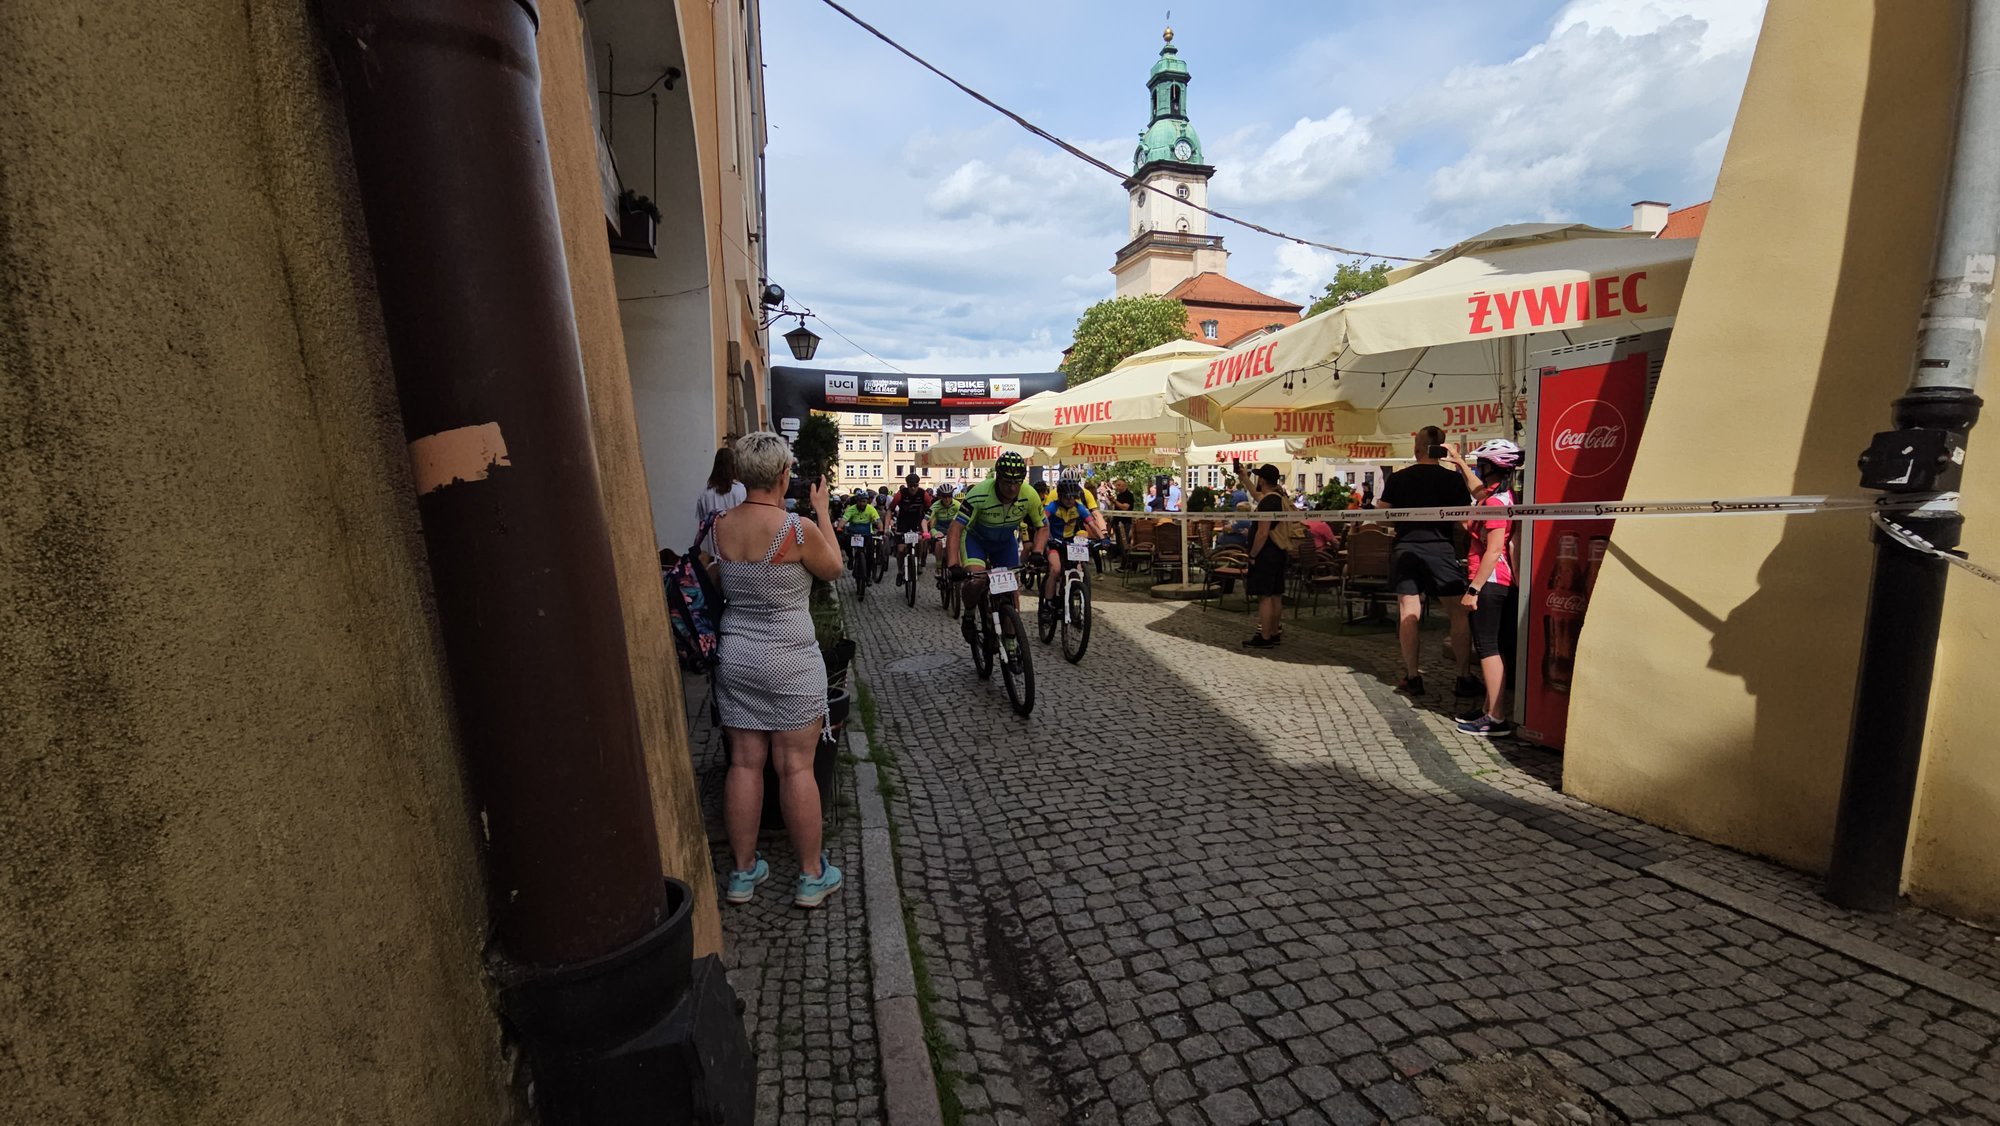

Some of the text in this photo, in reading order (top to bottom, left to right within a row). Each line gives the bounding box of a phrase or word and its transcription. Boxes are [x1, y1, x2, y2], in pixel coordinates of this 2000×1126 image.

[1468, 271, 1648, 334] ŻYWIEC
[1204, 341, 1279, 389] ŻYWIEC
[833, 381, 854, 389] UCI
[957, 381, 985, 389] BIKE
[1055, 401, 1112, 426] ŻYWIEC
[904, 418, 948, 430] START
[1604, 505, 1646, 513] SCOTT
[1722, 502, 1782, 510] SCOTT
[990, 572, 1013, 583] 1717
